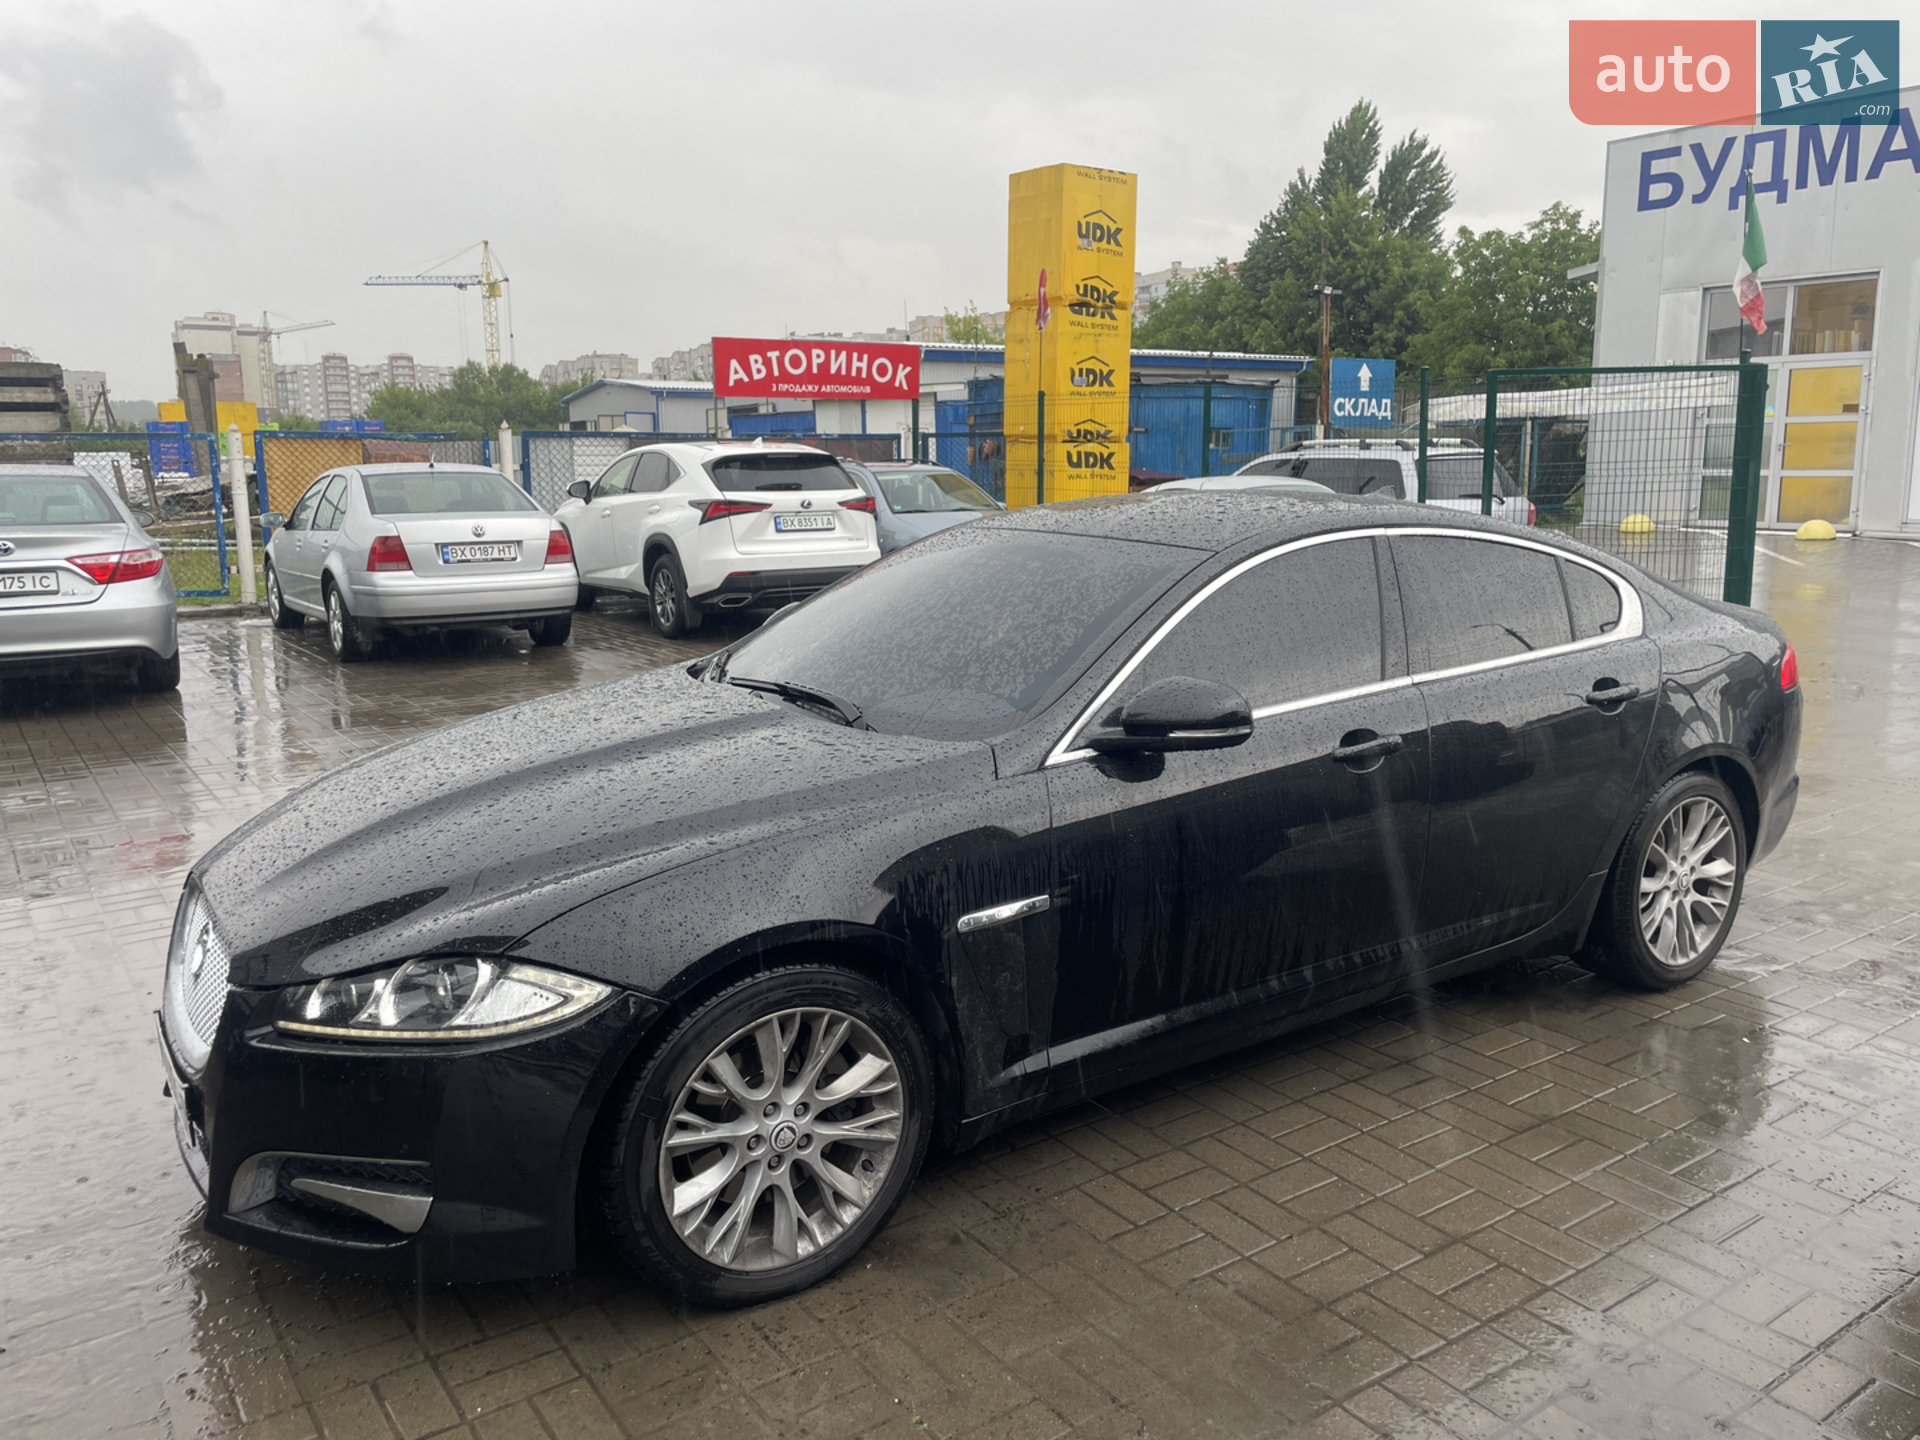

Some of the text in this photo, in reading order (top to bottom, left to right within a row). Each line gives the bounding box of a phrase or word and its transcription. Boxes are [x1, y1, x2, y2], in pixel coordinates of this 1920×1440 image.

[1076, 170, 1097, 180] WALL
[1098, 174, 1128, 186] SYSTEM
[1077, 219, 1124, 248] UDK
[1096, 246, 1124, 257] SYSTEM
[1069, 319, 1119, 331] WALL SYSTEM
[728, 348, 913, 391] АВТОРИНОК
[778, 383, 820, 394] ПРОДАЖУ
[820, 384, 871, 394] АВТОМОБІЛІВ
[1333, 397, 1392, 420] СКЛАД
[1066, 450, 1116, 471] UDK
[469, 545, 495, 558] 0187
